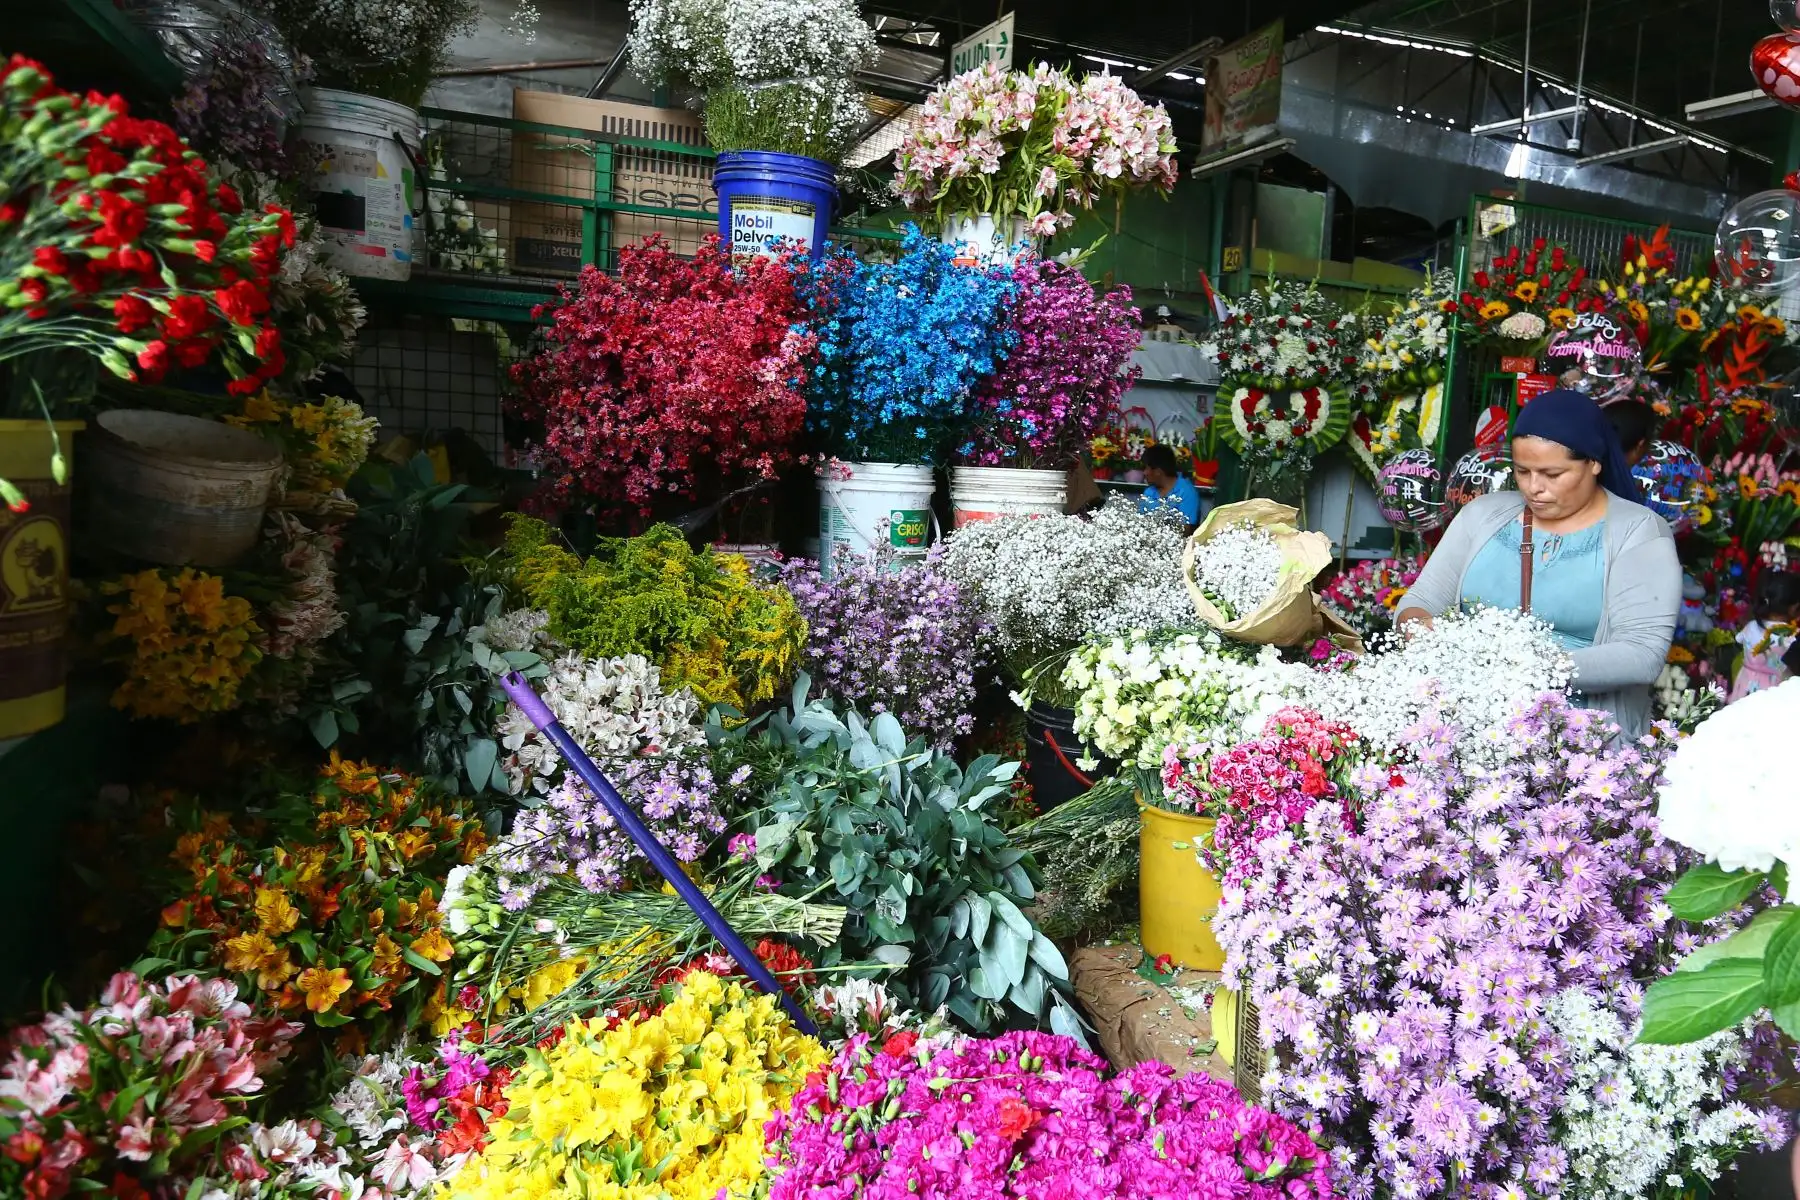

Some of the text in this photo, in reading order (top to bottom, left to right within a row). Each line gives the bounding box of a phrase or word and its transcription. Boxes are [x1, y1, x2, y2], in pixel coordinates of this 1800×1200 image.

[954, 39, 990, 75] SALIDA
[735, 214, 773, 229] Mobil
[734, 229, 774, 243] Delva
[734, 245, 760, 253] 25W-50
[1226, 251, 1240, 266] 20
[1566, 312, 1621, 339] Feliz
[1451, 451, 1491, 485] Feliz
[1244, 1001, 1261, 1076] SEGURIDAD
